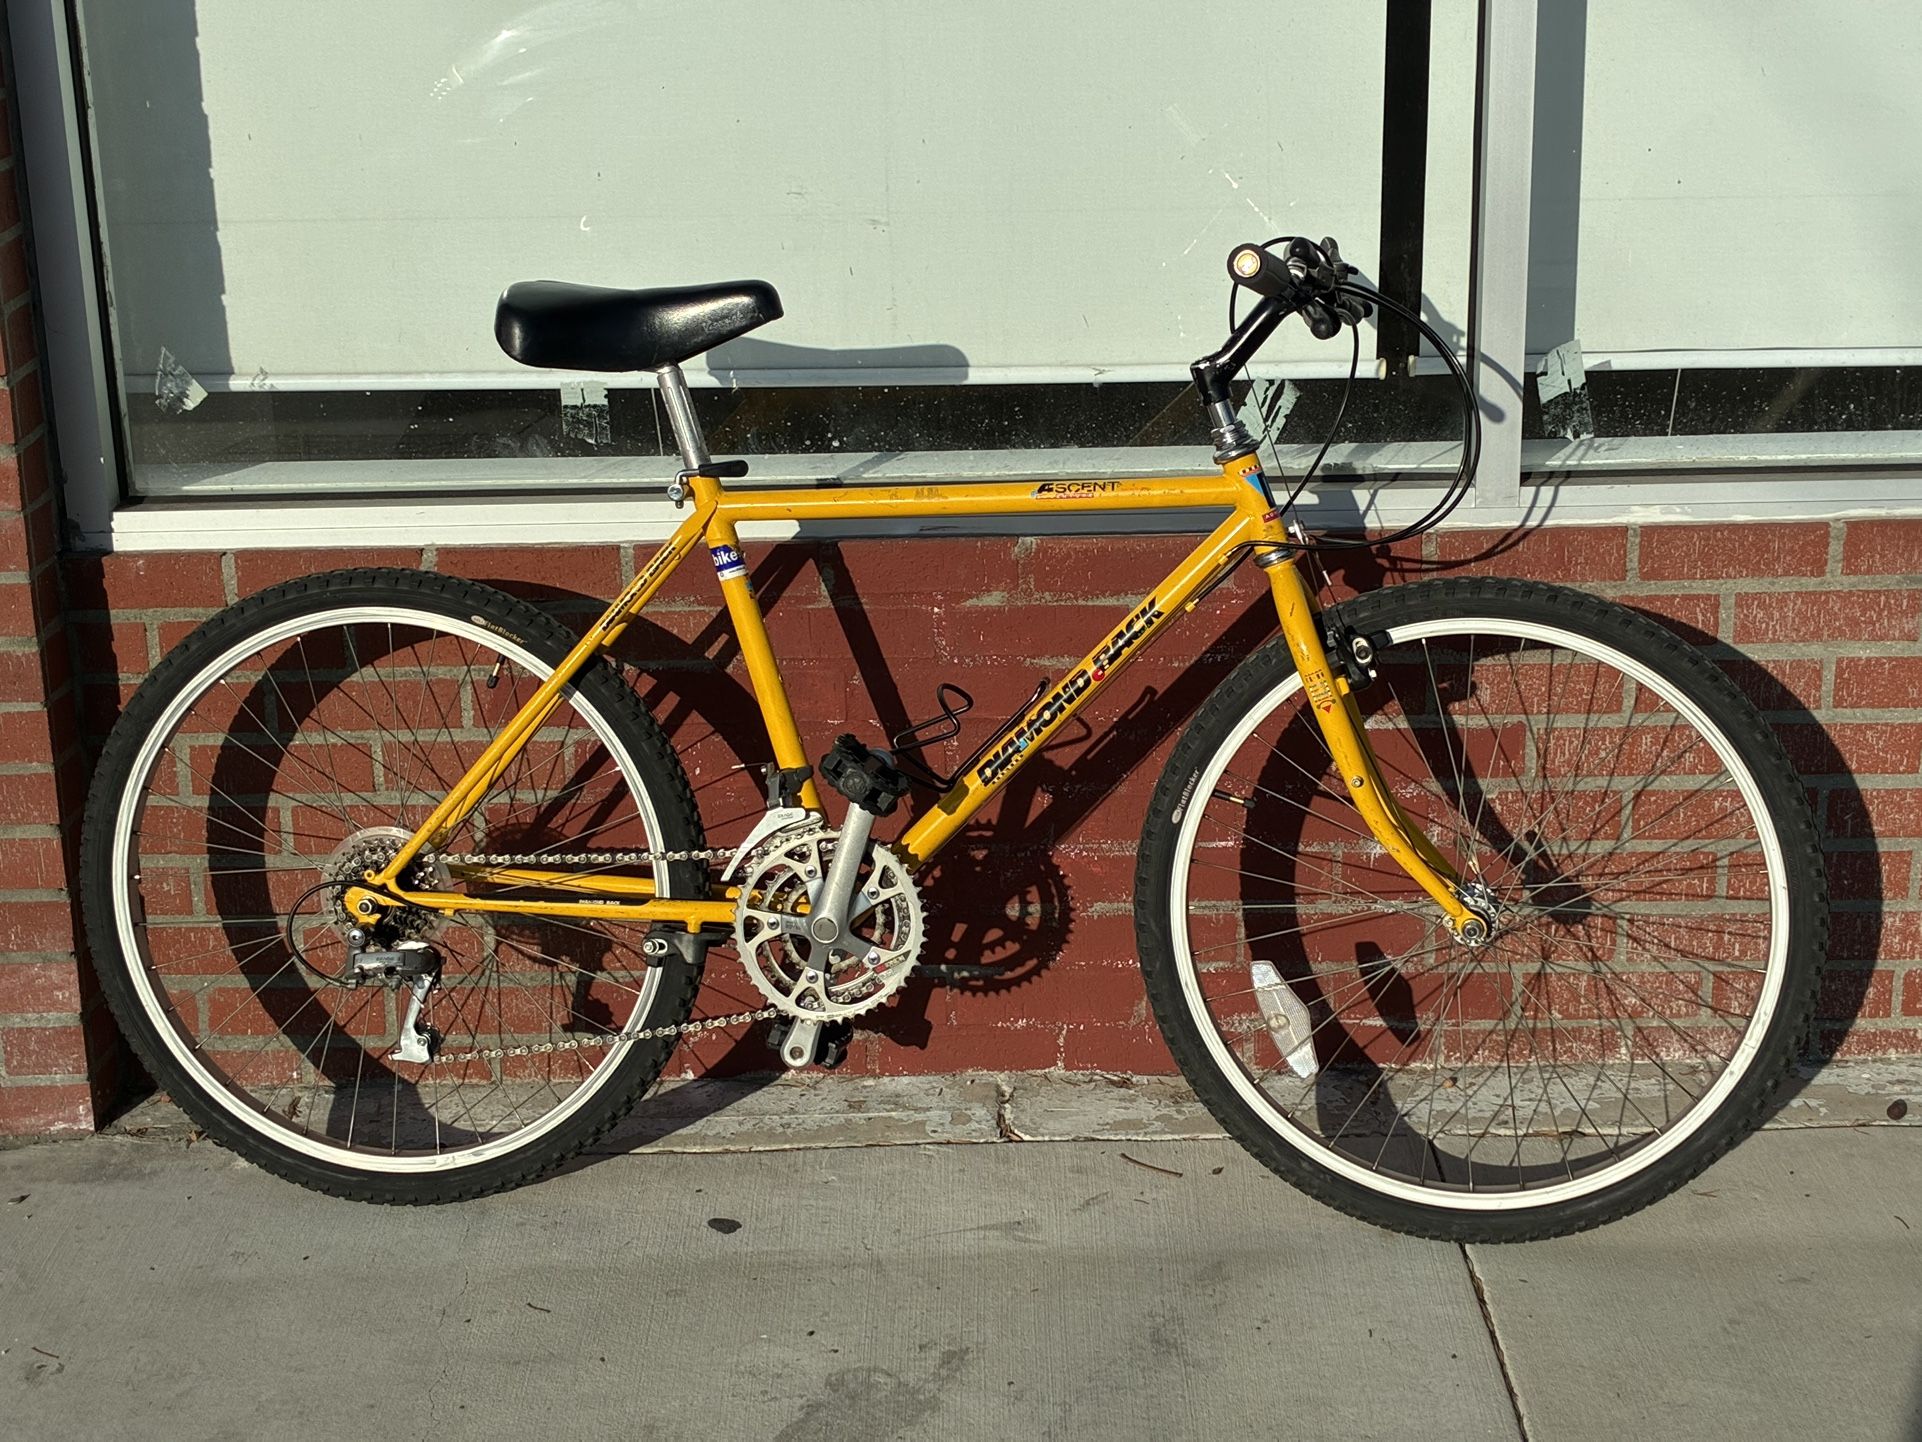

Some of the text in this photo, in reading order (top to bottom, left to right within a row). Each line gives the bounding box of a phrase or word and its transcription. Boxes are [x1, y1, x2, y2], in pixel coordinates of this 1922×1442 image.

[1037, 481, 1120, 494] ASCENT
[977, 596, 1165, 788] DIAMOND BACK
